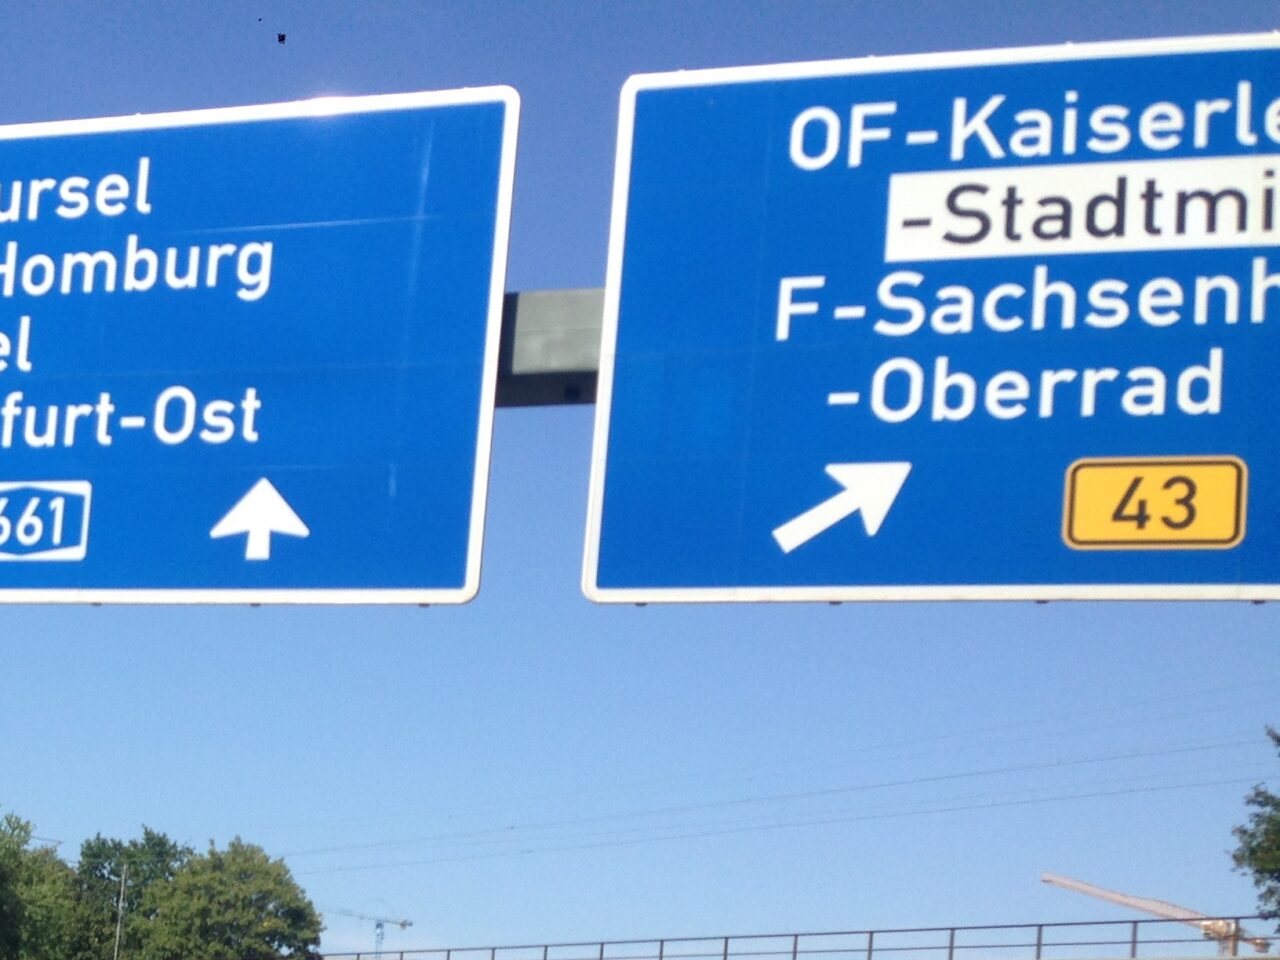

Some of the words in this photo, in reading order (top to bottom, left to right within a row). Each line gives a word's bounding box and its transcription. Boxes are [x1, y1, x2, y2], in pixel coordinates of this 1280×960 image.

[902, 170, 1276, 244] -Stadtmi
[826, 348, 1223, 423] -Oberrad
[1112, 476, 1198, 530] 43
